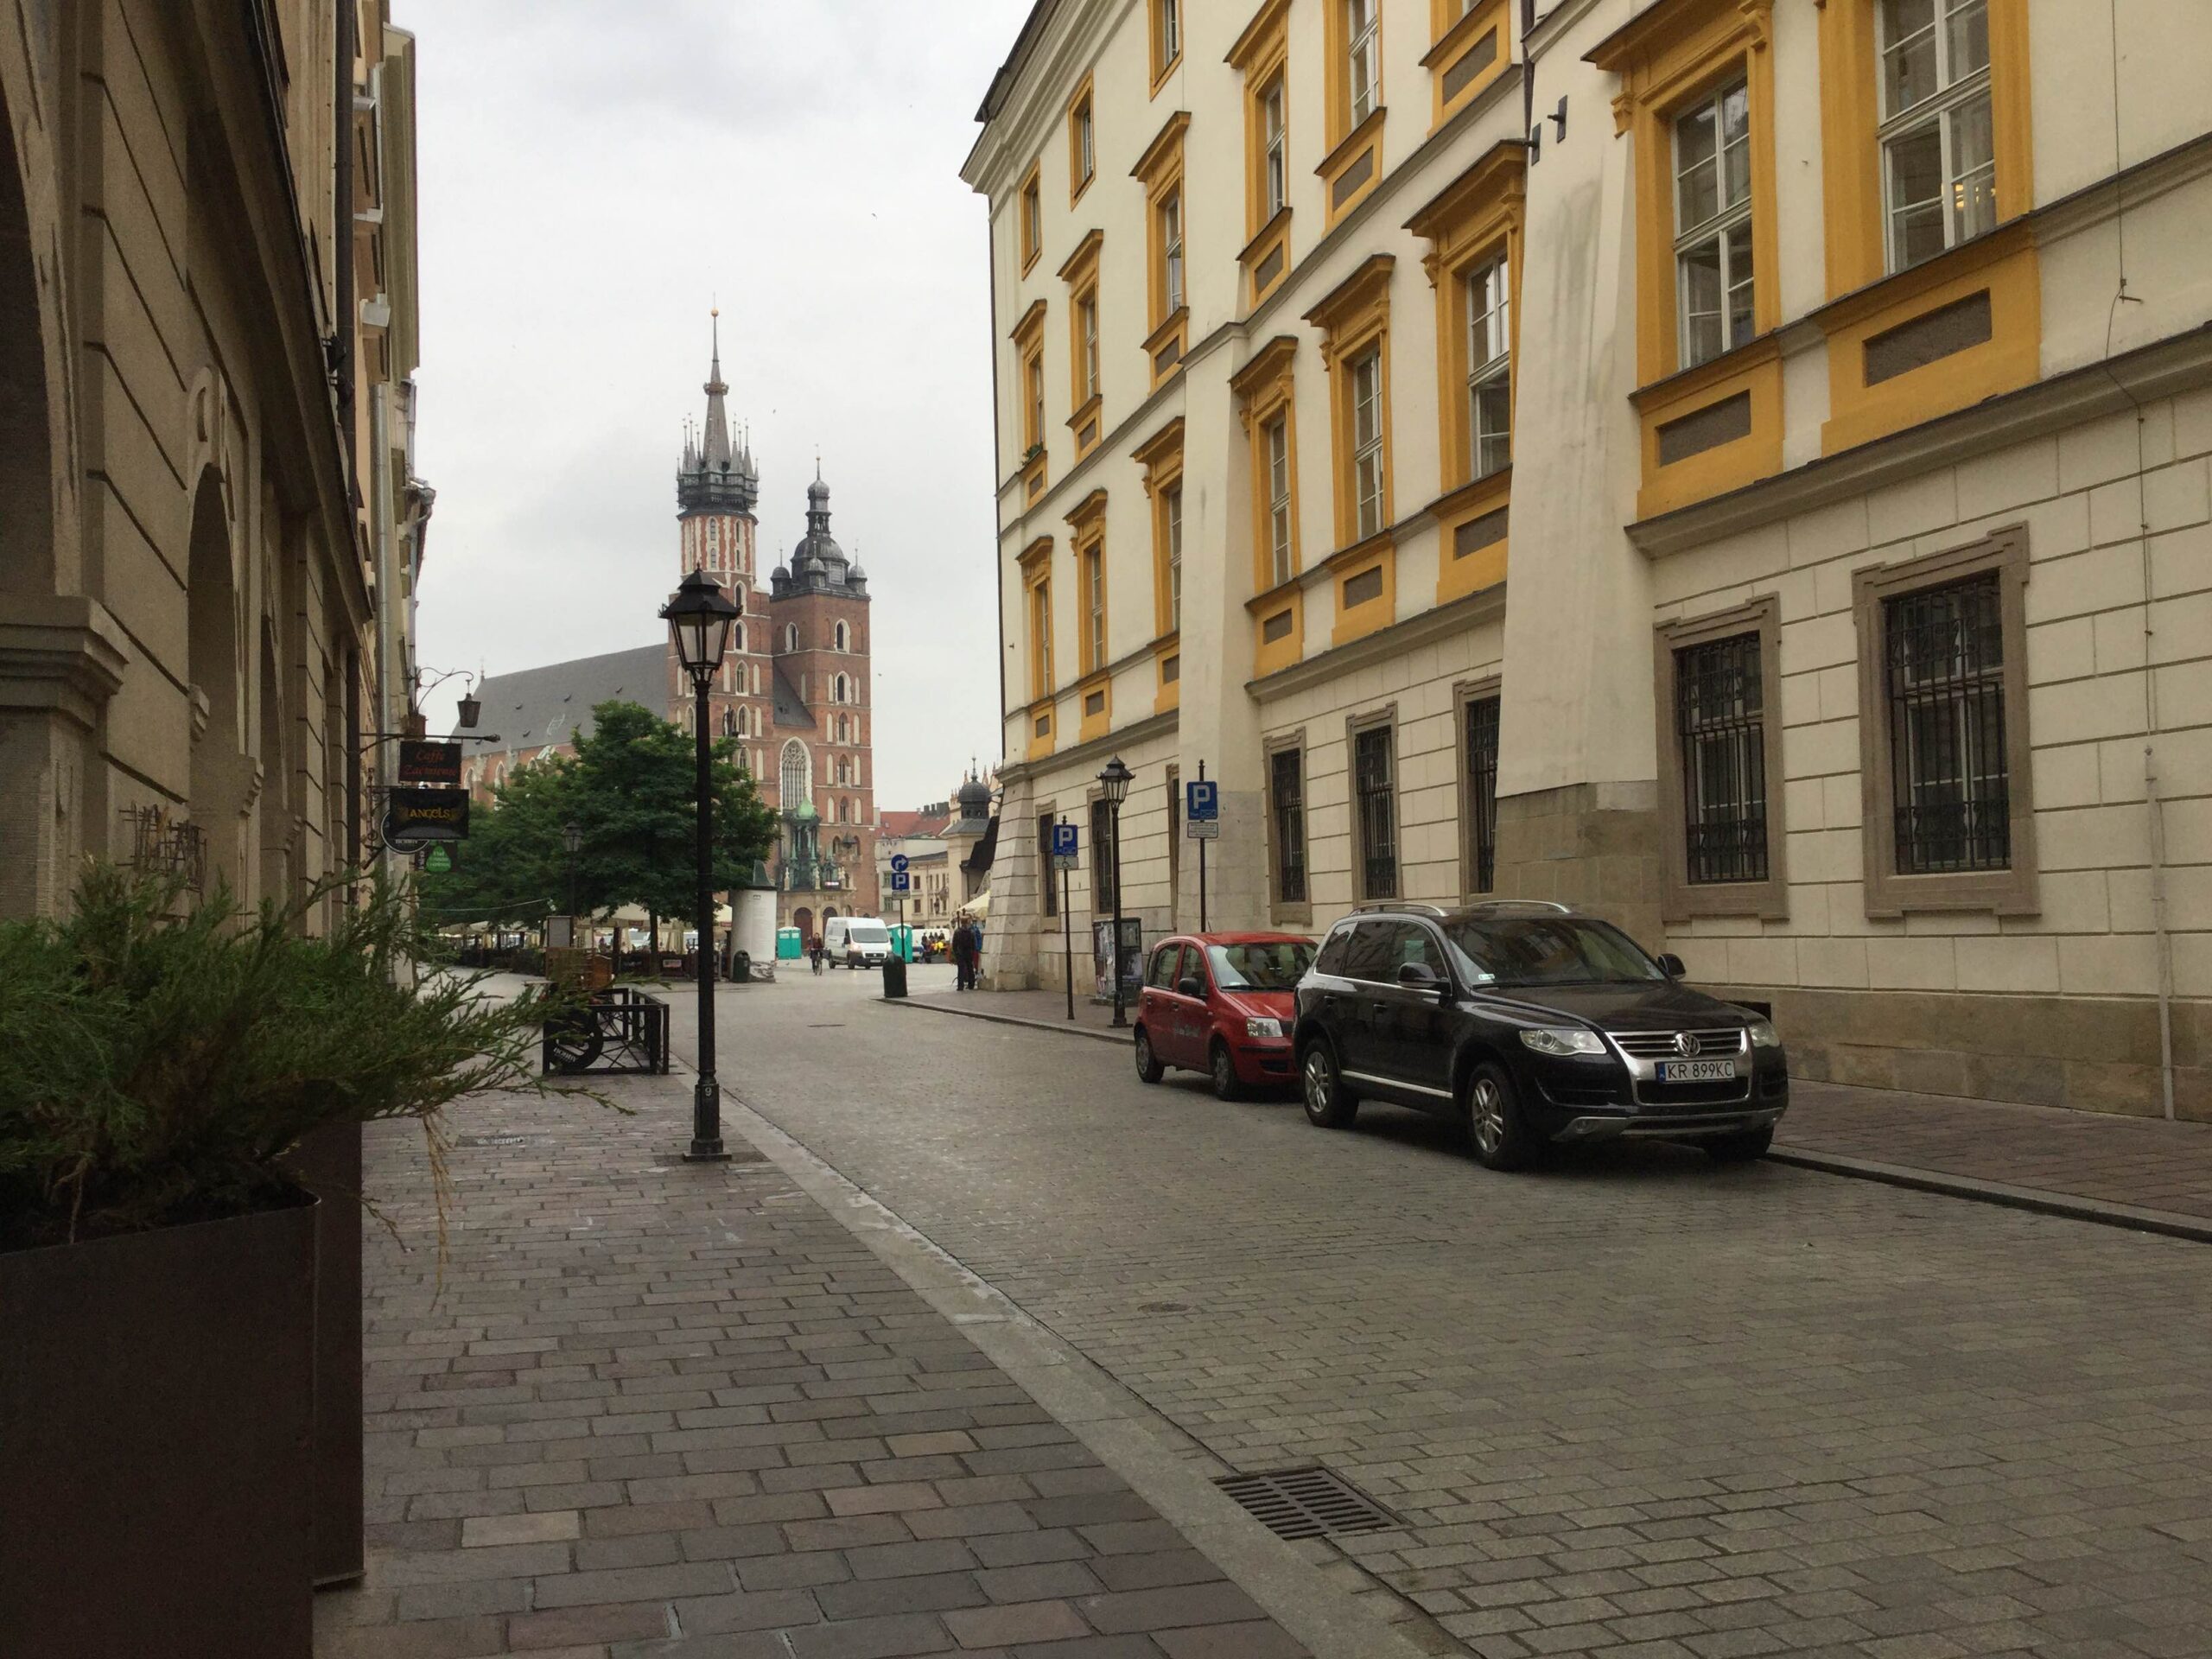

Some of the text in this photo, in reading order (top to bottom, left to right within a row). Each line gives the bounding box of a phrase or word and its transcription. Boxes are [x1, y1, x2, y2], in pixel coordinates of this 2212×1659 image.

[1192, 785, 1211, 810] P
[1058, 828, 1073, 847] P
[895, 874, 906, 888] P
[1667, 1064, 1688, 1079] KR
